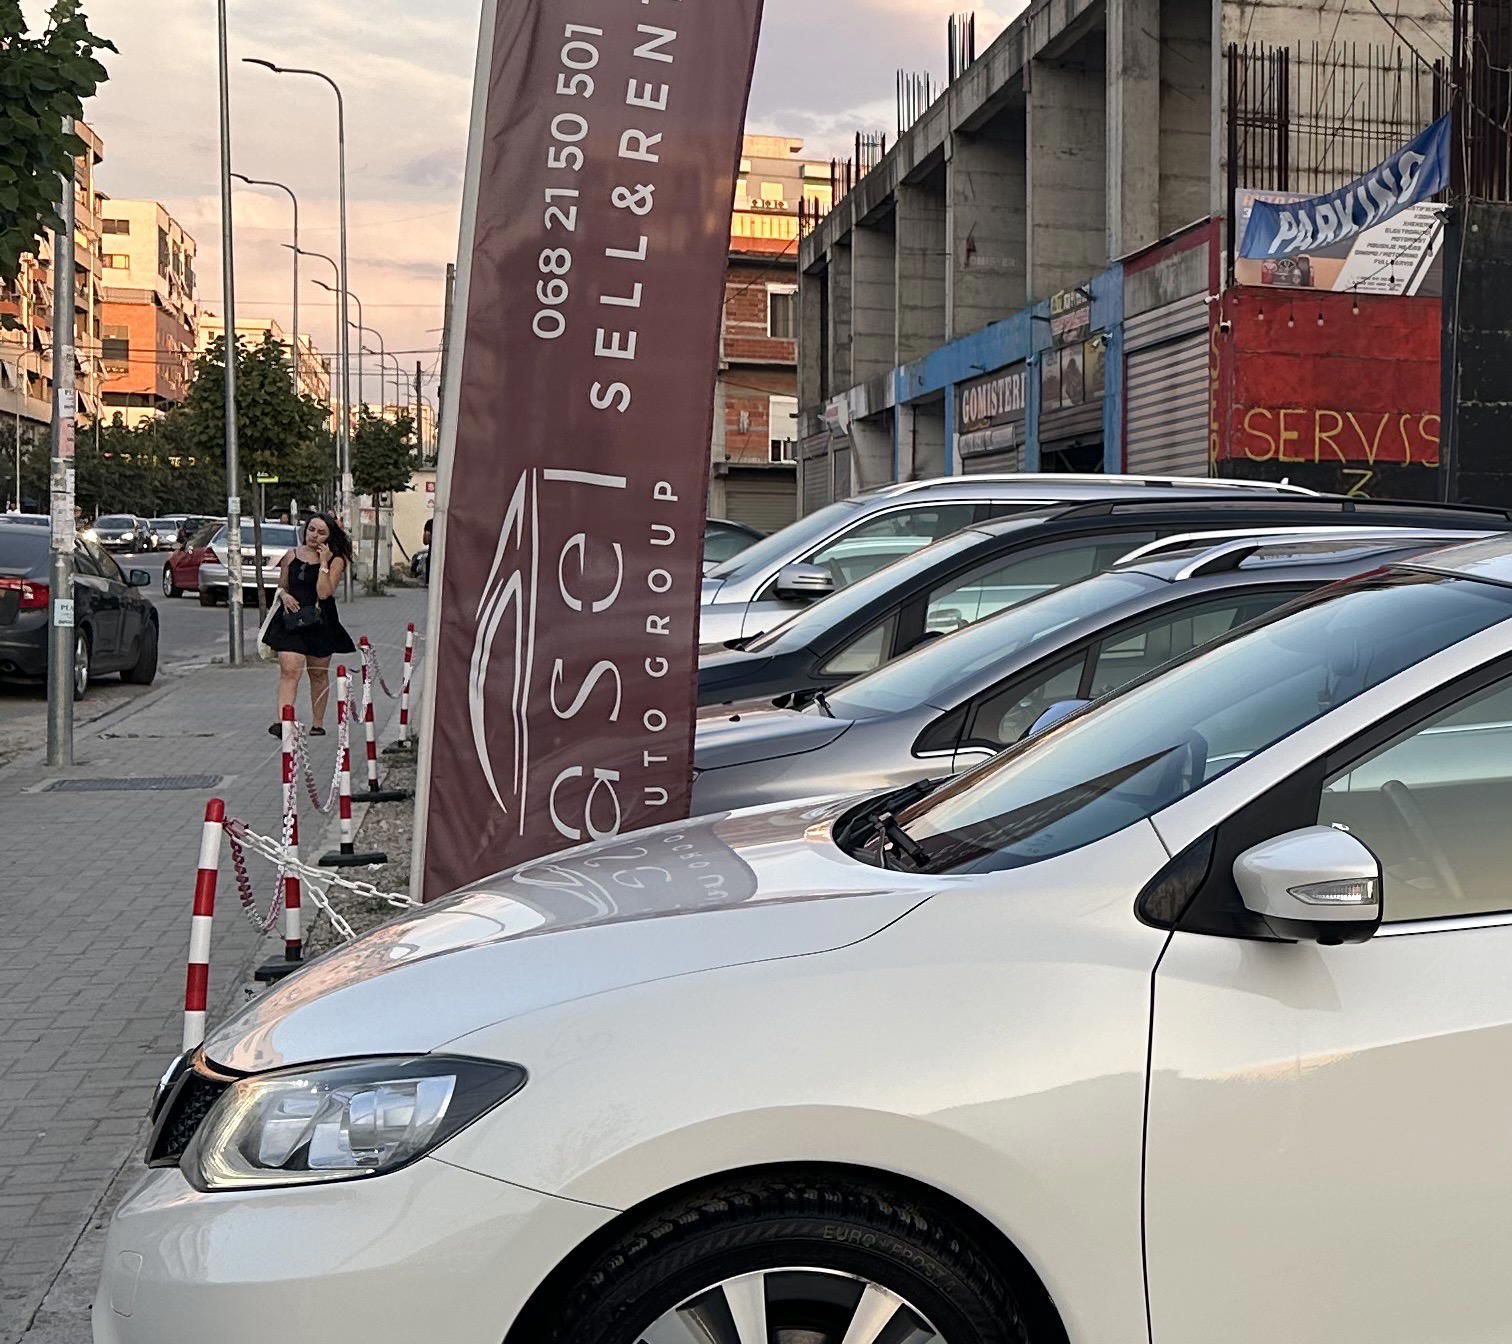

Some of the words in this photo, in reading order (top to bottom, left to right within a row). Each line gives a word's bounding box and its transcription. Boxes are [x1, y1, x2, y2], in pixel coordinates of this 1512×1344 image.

[556, 23, 603, 99] 501
[547, 112, 589, 172] 50
[544, 188, 580, 232] 21
[1268, 150, 1427, 255] PARKING
[532, 247, 572, 339] 068
[962, 372, 1026, 424] GOMISTERI
[1244, 407, 1440, 468] SERVIS
[644, 480, 678, 678] GROUP
[643, 709, 668, 806] UTO
[822, 1225, 876, 1248] EURO
